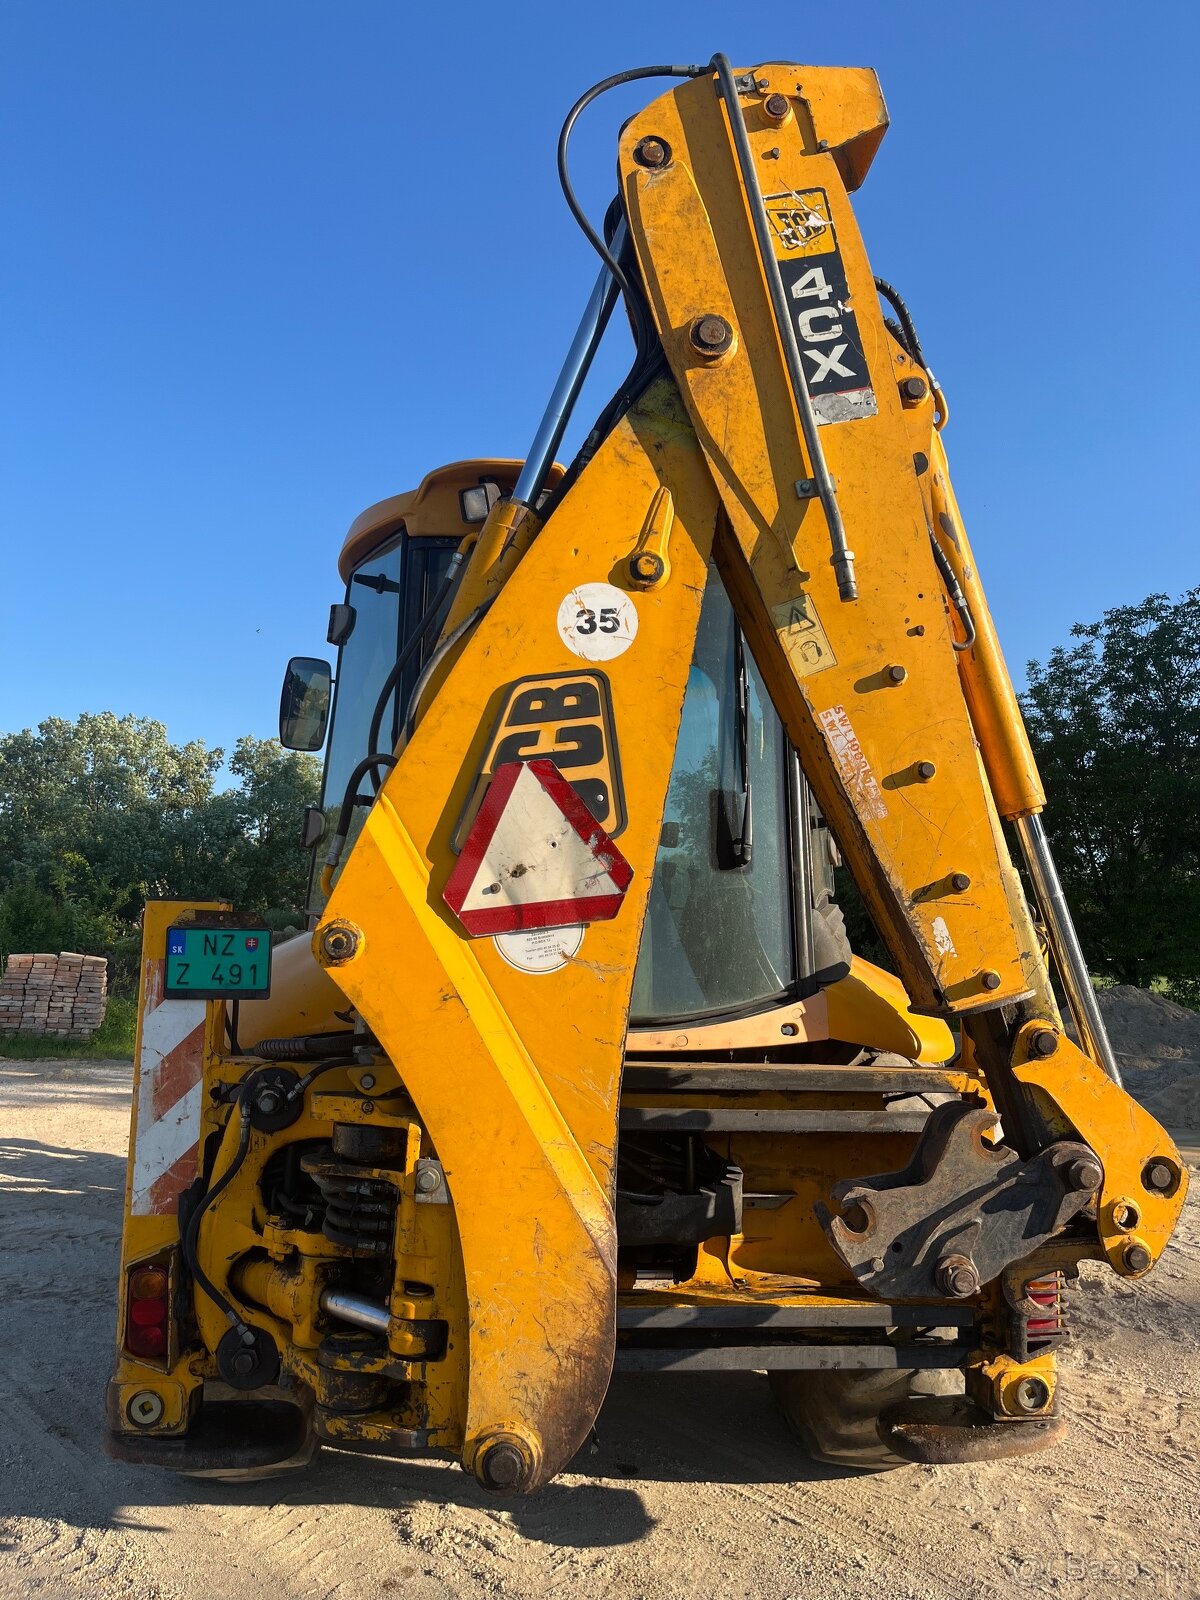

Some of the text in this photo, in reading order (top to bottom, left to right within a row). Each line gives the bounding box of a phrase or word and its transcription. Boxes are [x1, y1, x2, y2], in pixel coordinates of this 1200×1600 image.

[791, 266, 857, 384] 4CX
[576, 607, 620, 635] 35
[172, 945, 183, 953] SK
[203, 934, 235, 956] NZ
[176, 963, 257, 985] Z 491
